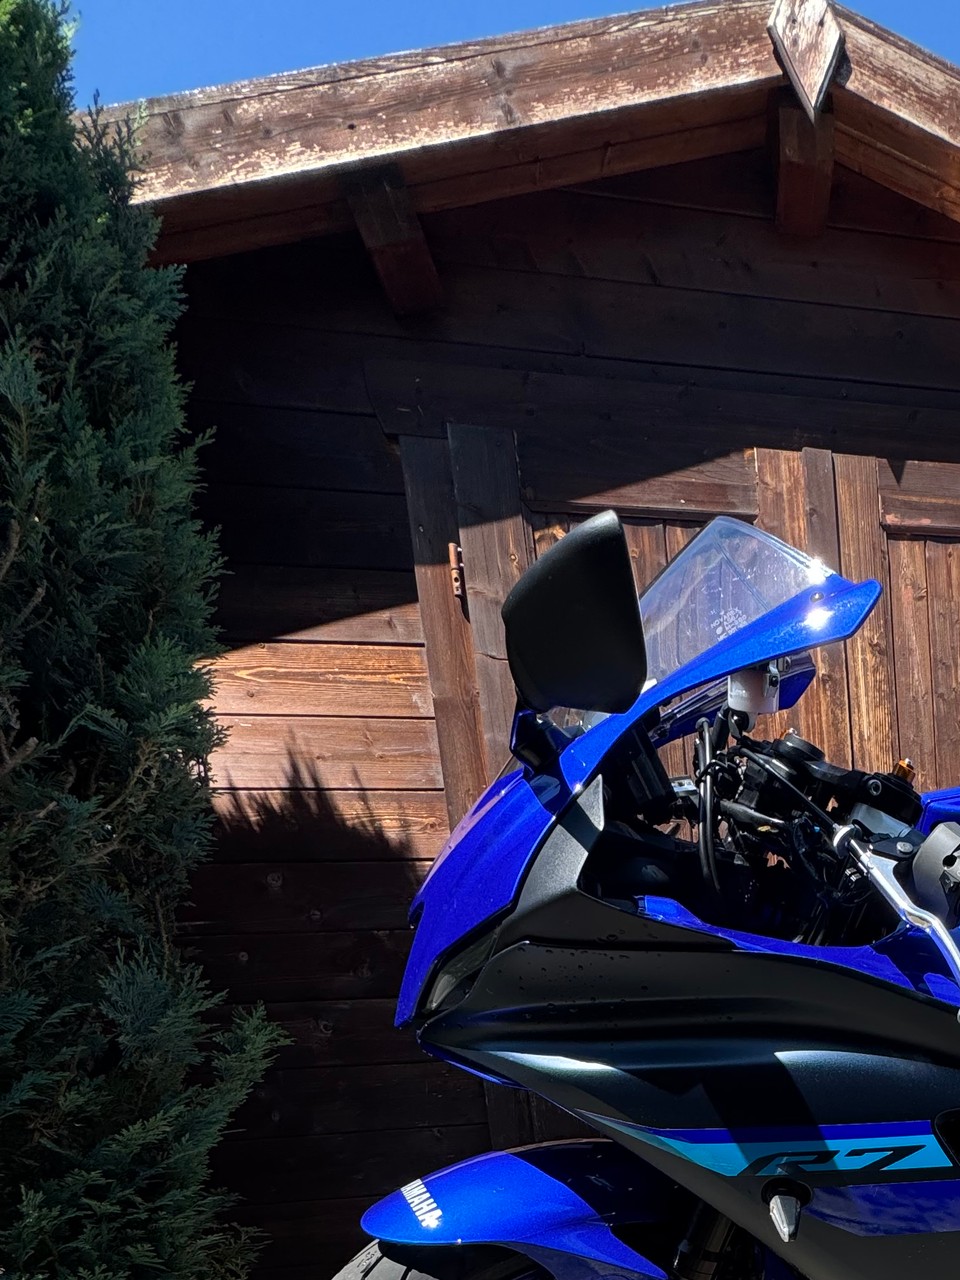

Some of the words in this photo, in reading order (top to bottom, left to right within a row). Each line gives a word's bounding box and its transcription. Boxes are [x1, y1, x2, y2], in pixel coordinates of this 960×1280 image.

[711, 606, 742, 628] NOVAREX
[737, 1145, 926, 1176] R7
[401, 1179, 442, 1227] AMAHA
